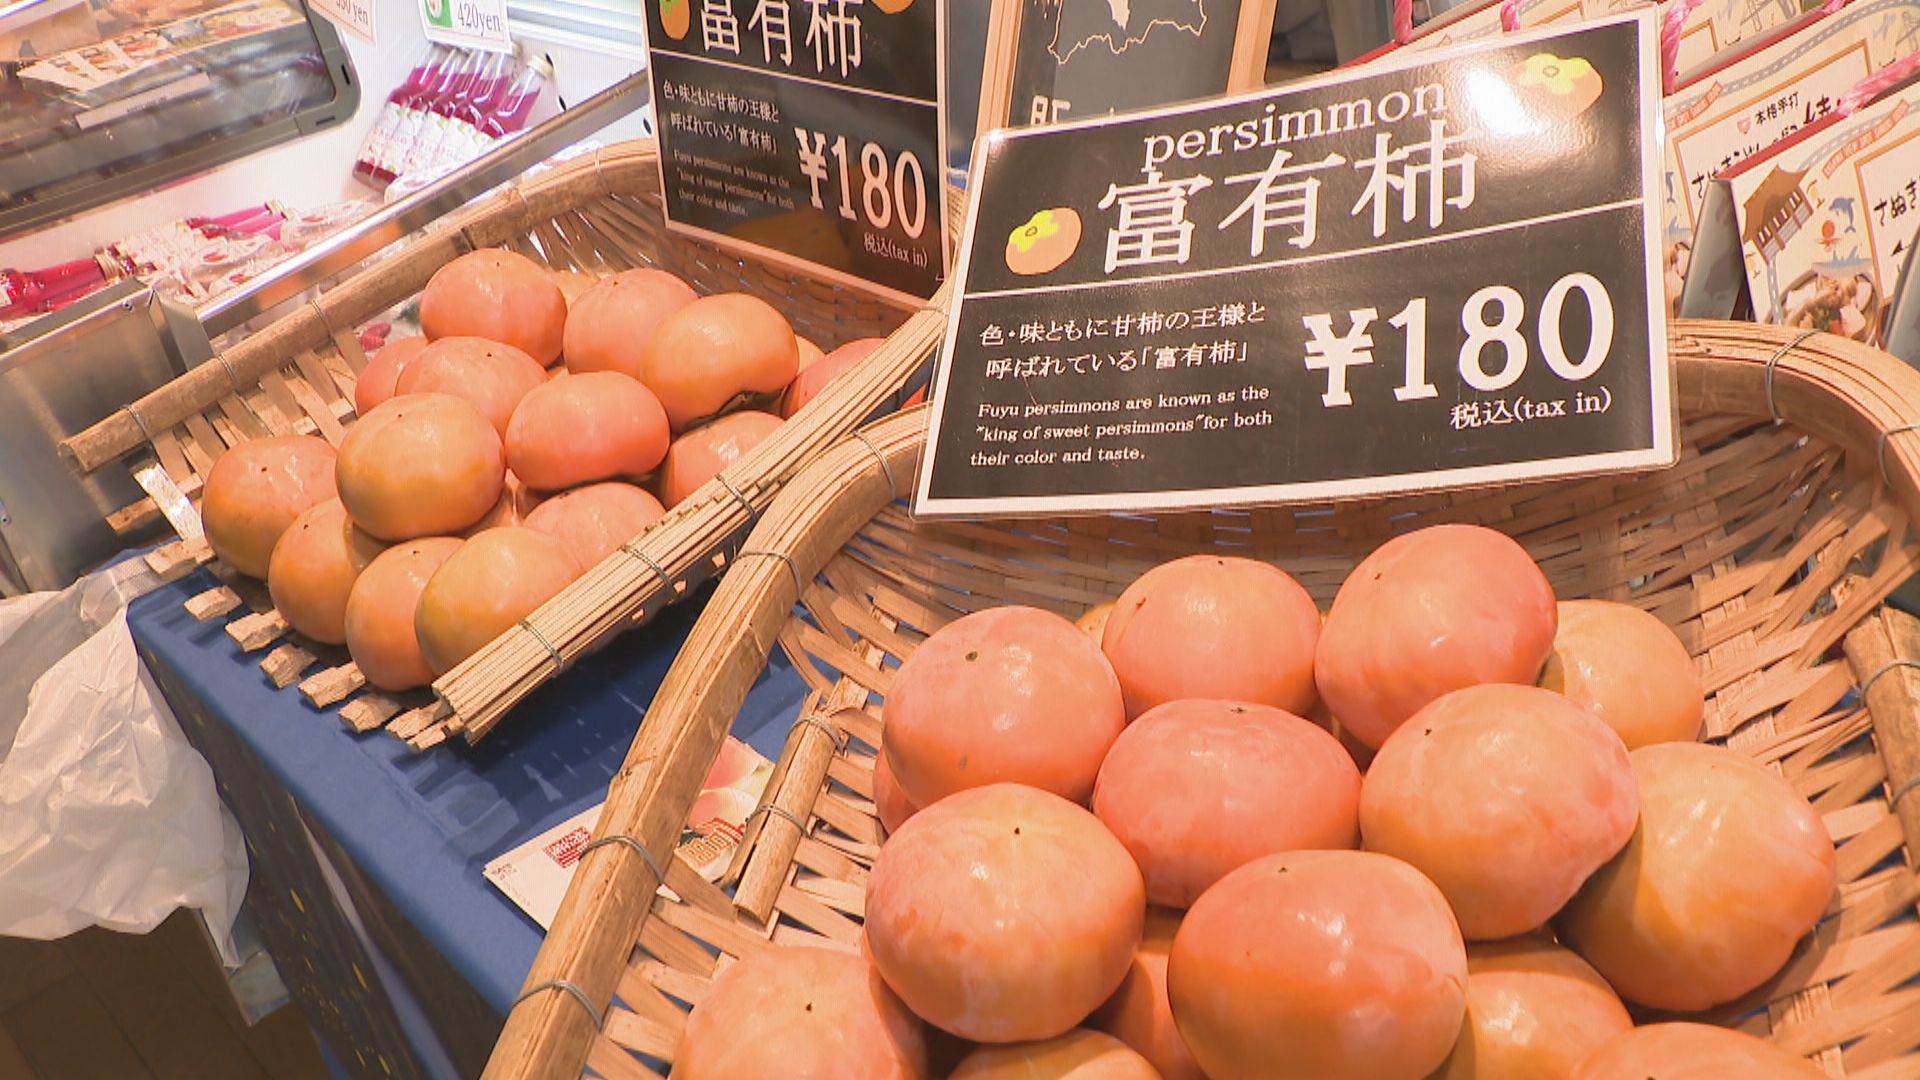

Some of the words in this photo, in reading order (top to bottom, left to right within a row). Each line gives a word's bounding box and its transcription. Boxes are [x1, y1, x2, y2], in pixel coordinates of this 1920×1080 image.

[352, 4, 369, 26] yen
[457, 3, 501, 37] 420yen
[1142, 81, 1447, 172] persimmon
[793, 127, 926, 239] ¥180
[1097, 116, 1480, 274] 富有柿
[979, 301, 1266, 346] 色・味ともに甘柿の王様と
[1302, 272, 1615, 408] ¥180
[985, 340, 1248, 380] 呼ばれている「富有柿」
[978, 402, 1020, 419] Fuyu
[1024, 398, 1120, 418] persimmons
[1125, 397, 1152, 410] are
[1158, 388, 1211, 408] known
[1218, 390, 1235, 403] as
[1241, 386, 1269, 401] the
[1575, 386, 1613, 414] in)
[1023, 425, 1039, 441] of
[1043, 425, 1090, 440] sweet
[1234, 411, 1272, 428] both
[970, 449, 1009, 467] their
[1014, 449, 1057, 465] color
[1062, 446, 1092, 463] and
[1097, 446, 1146, 462] taste.
